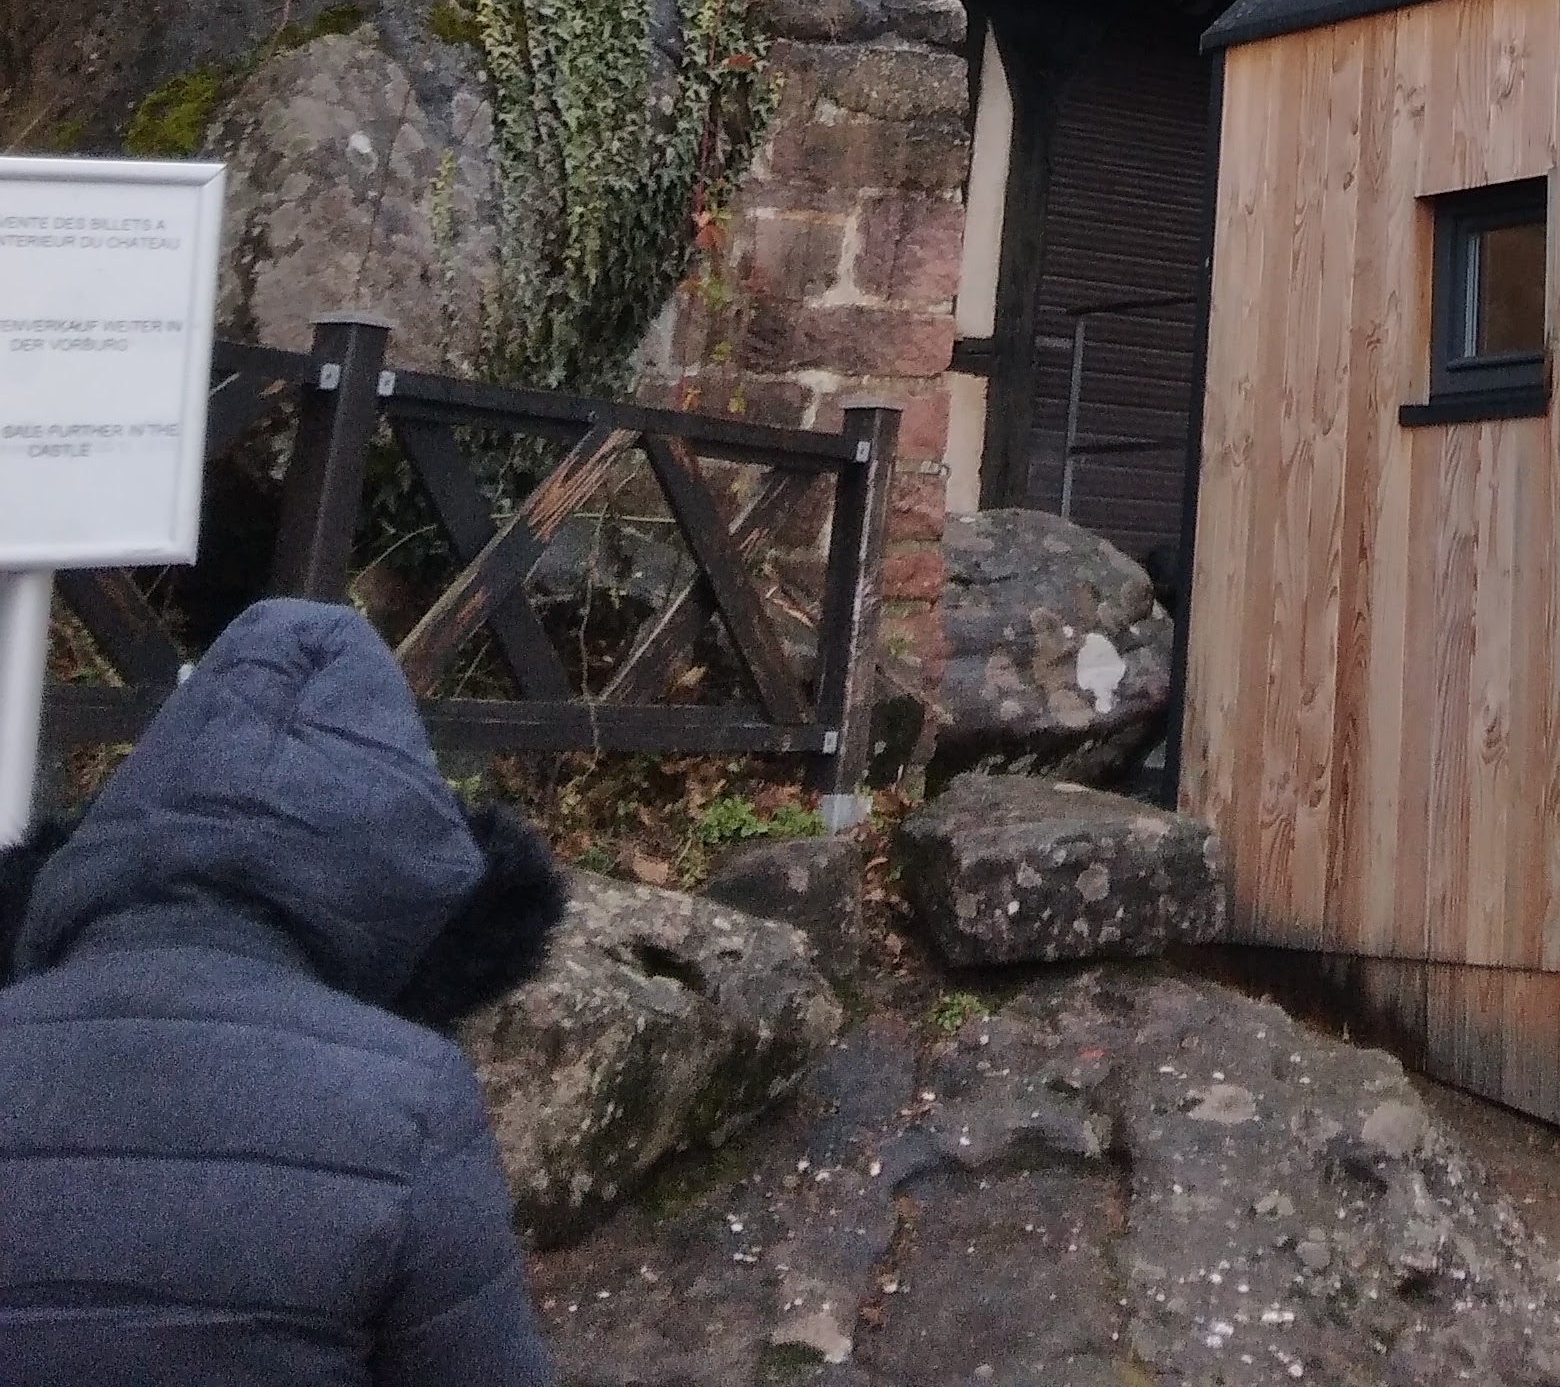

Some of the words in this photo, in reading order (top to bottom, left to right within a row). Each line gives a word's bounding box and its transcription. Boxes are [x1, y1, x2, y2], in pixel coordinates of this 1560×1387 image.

[54, 216, 86, 231] DES
[90, 217, 152, 232] BILLETS
[80, 236, 104, 249] DU
[106, 236, 182, 250] CHATEAU
[0, 319, 99, 333] ENVERKAUF
[103, 320, 162, 333] WEITER
[9, 338, 45, 352] DER
[49, 338, 129, 352] VORBURG
[47, 424, 123, 438] FURTHER
[148, 423, 179, 437] THE
[28, 442, 92, 458] CASTLE
